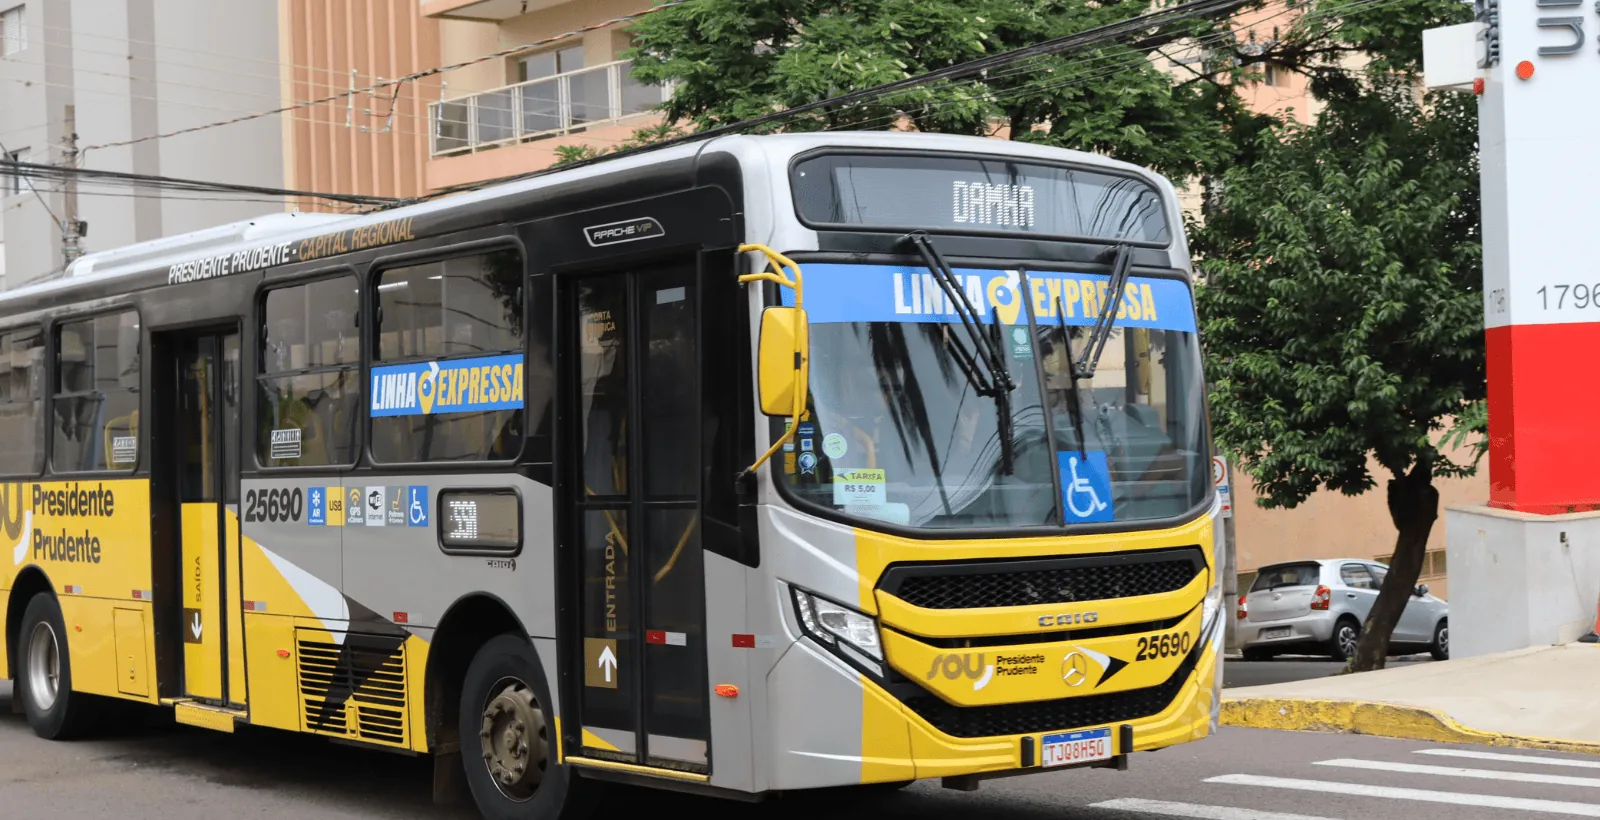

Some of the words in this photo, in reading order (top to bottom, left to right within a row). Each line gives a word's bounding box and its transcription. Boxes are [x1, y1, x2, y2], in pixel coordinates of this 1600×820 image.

[953, 181, 1034, 226] DAMHA
[594, 225, 635, 240] APACHE
[636, 222, 652, 233] VIP
[168, 254, 232, 284] PRESIDENTE
[231, 241, 292, 273] PRUDENTE
[300, 231, 347, 261] CAPITAL
[351, 217, 415, 249] REGIONAL
[372, 372, 416, 410] LINHA
[437, 363, 524, 406] EXPRESSA
[850, 472, 882, 481] TARIFA
[32, 482, 114, 517] Presidente
[245, 487, 302, 522] 25690
[329, 501, 342, 511] USB
[350, 507, 361, 516] GPS
[312, 508, 320, 517] AR
[33, 529, 100, 564] Prudente
[605, 530, 616, 632] ENTRADA
[1038, 612, 1098, 626] CAIO
[996, 653, 1045, 664] Presidente
[1136, 631, 1190, 662] 25690
[996, 665, 1038, 676] Prudente
